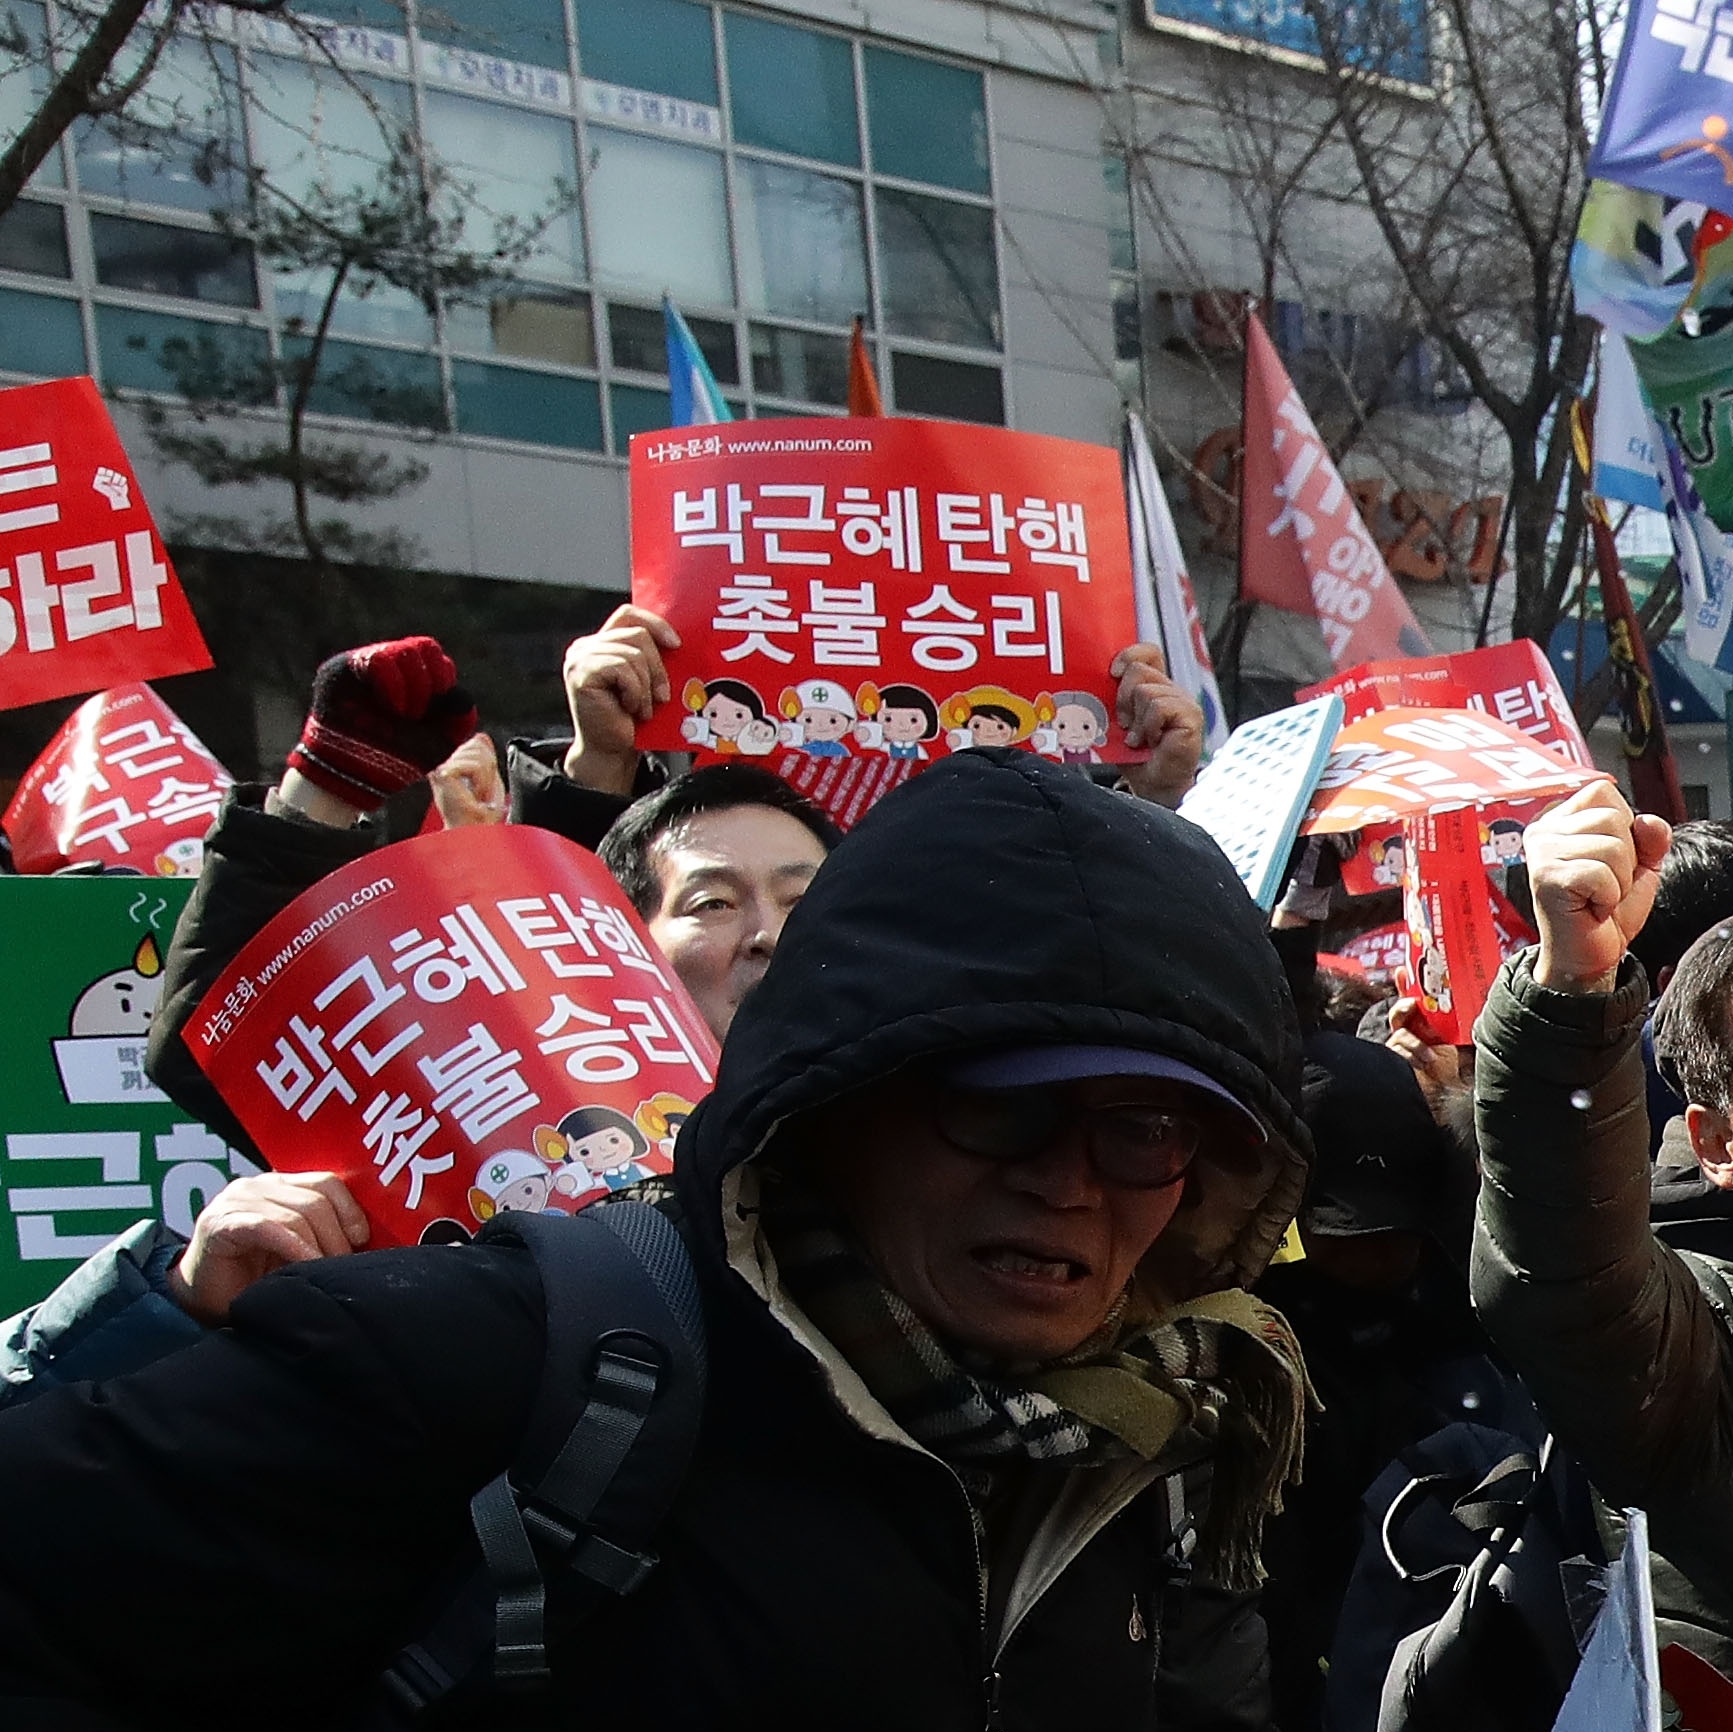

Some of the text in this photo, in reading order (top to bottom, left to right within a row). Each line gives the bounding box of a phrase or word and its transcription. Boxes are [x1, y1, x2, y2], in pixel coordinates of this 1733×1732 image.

[647, 435, 873, 464] 나눔문화 www.nanum.com
[672, 483, 923, 573] 박근혜
[936, 492, 1091, 583] 탄핵
[712, 574, 1064, 675] 촛불 승리
[200, 876, 394, 1046] 나눔문화 www.nanum.com
[256, 893, 671, 1121] 박근혜 탄핵
[361, 992, 714, 1210] 촛불 승리
